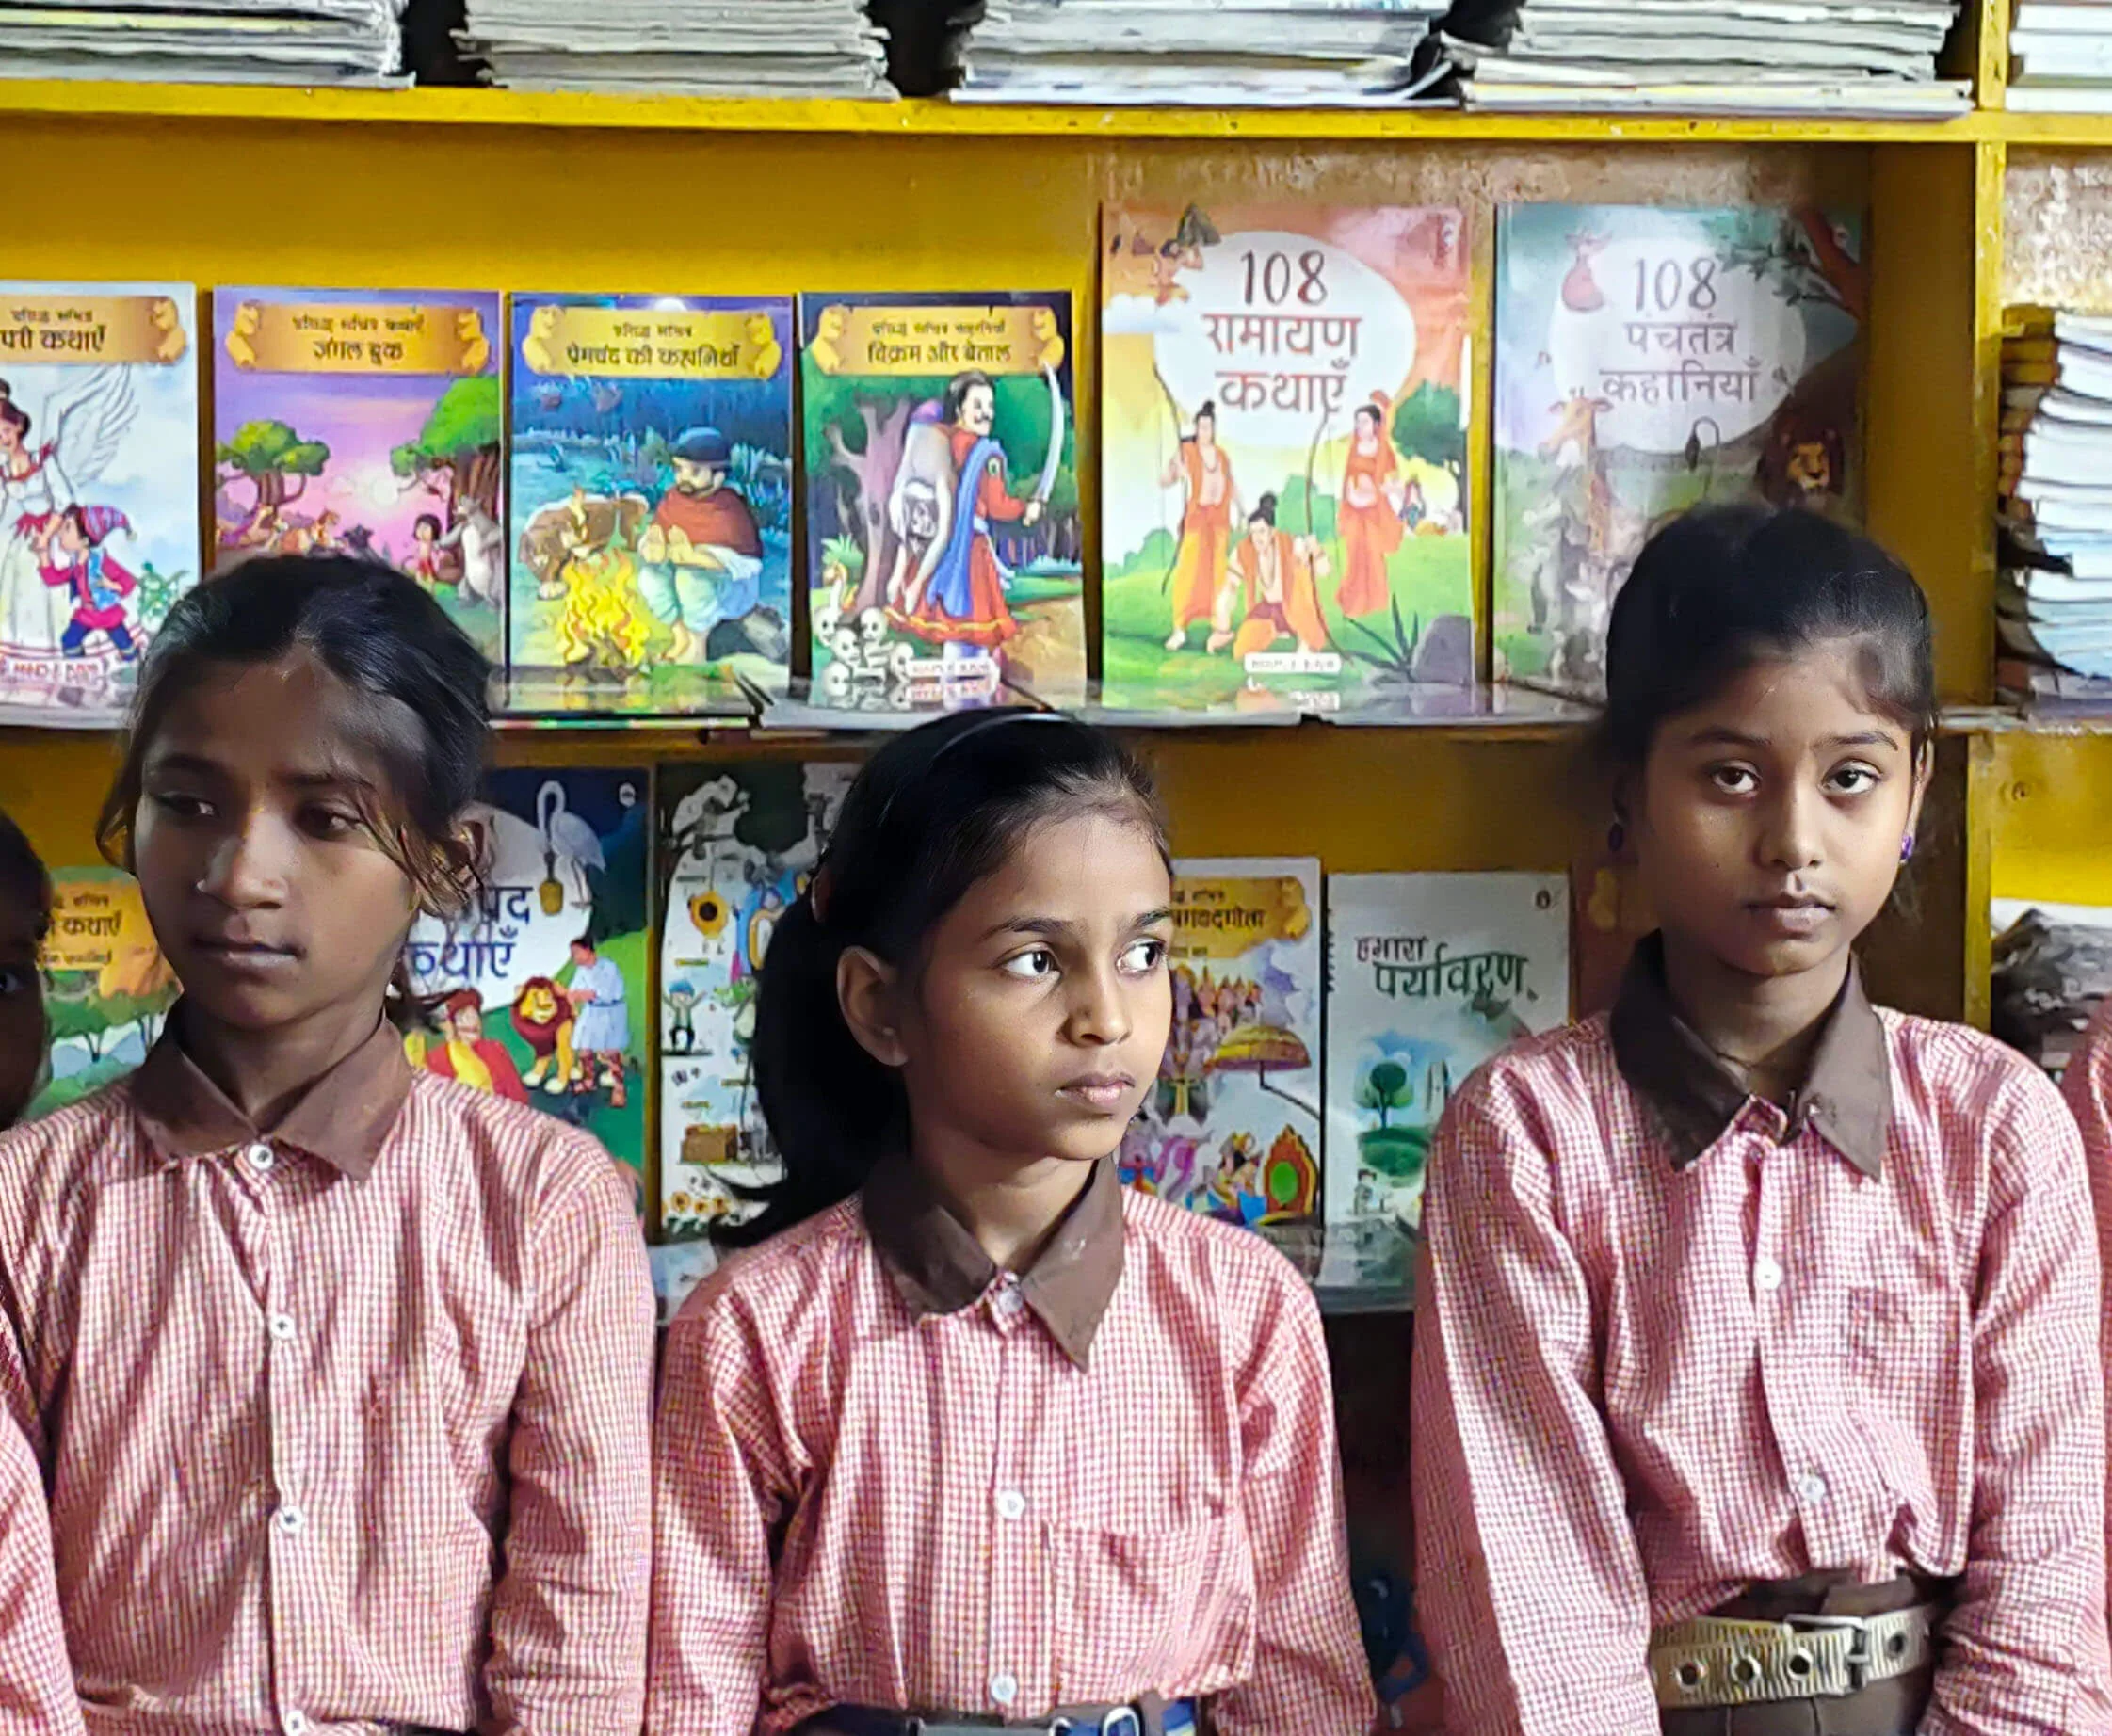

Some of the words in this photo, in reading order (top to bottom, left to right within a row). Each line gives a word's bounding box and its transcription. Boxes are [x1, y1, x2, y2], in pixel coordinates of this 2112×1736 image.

[1240, 249, 1329, 307] 108
[1634, 257, 1717, 312] 108
[868, 340, 922, 364] विक्रम
[927, 340, 959, 363] और
[964, 338, 1012, 362] बेताल
[1201, 313, 1363, 357] रामायण
[1215, 358, 1348, 412] कथाएँ
[1599, 355, 1763, 403] कहानियाँ
[1372, 942, 1530, 1000] पर्यावरण
